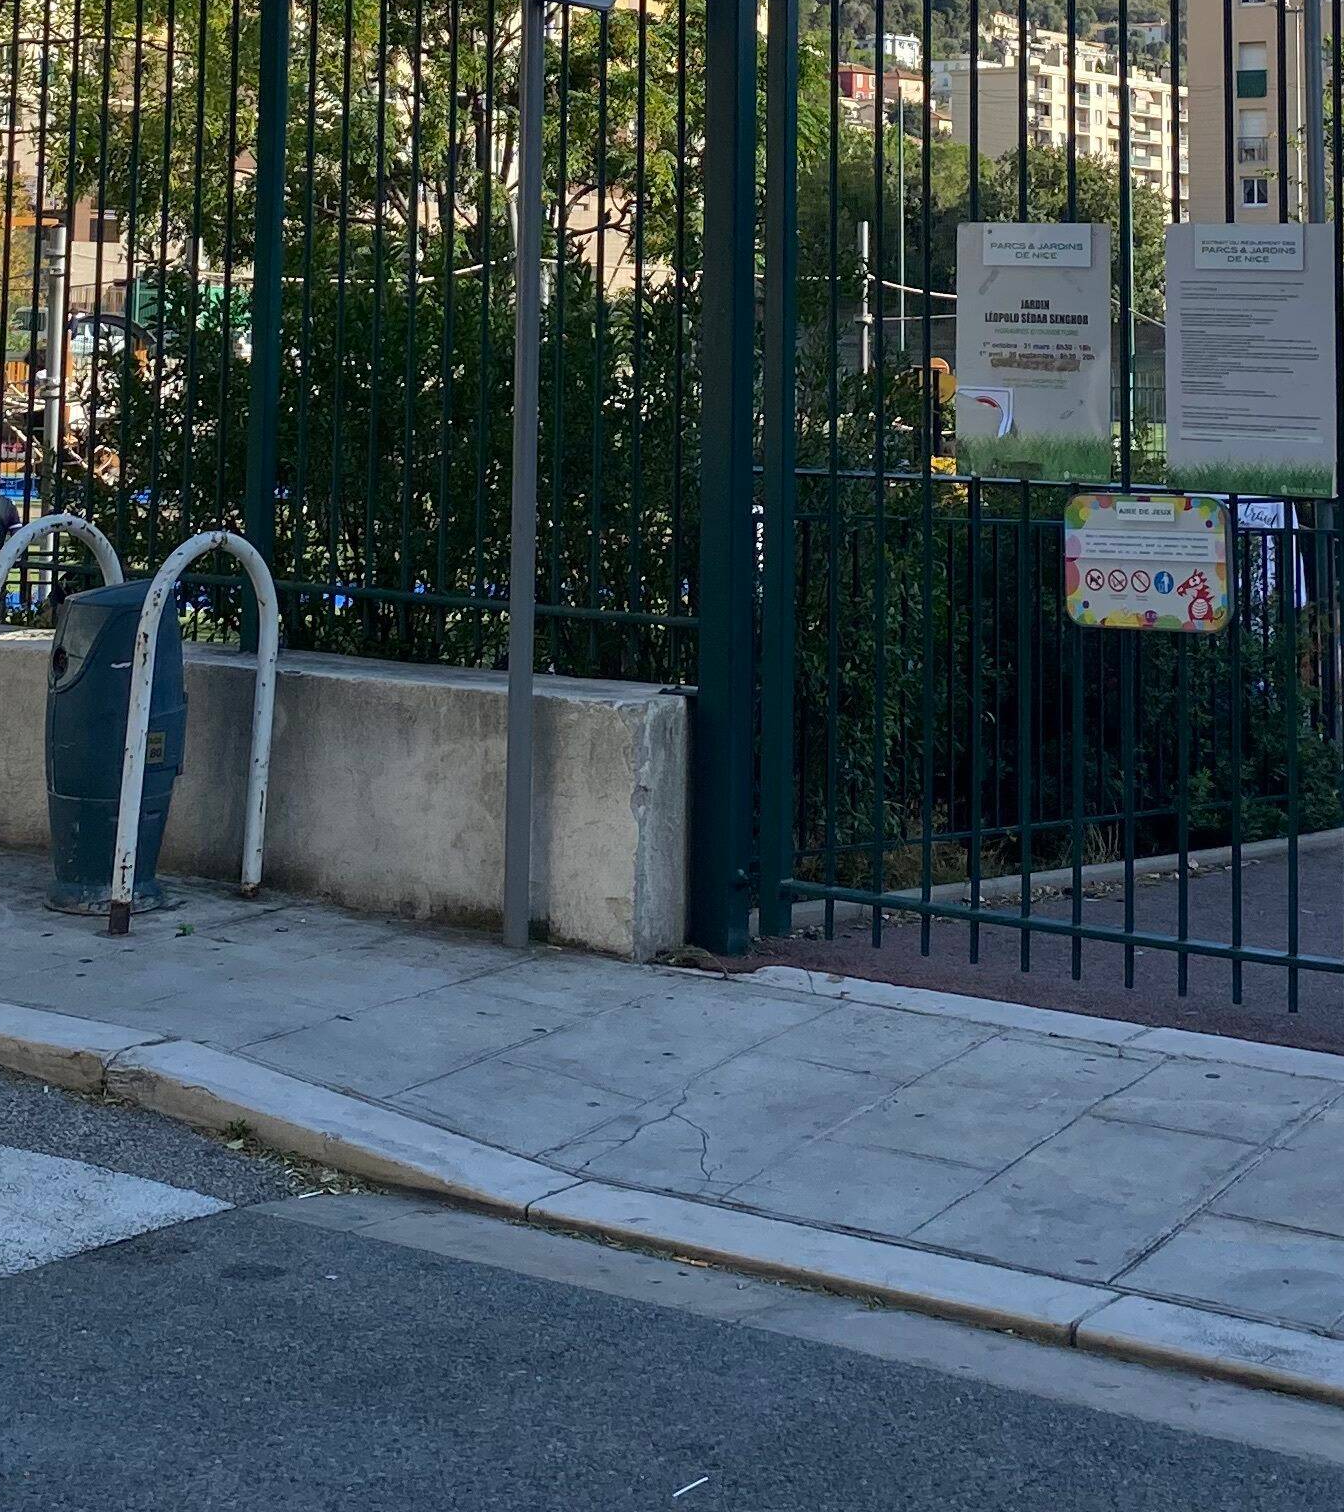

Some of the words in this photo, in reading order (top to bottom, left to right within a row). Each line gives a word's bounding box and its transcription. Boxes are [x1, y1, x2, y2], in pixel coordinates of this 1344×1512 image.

[1201, 246, 1238, 254] PARCS
[1239, 246, 1247, 254] &
[1249, 247, 1296, 255] JARDINS
[1032, 252, 1057, 260] NICE
[1227, 255, 1242, 263] DE
[1020, 299, 1050, 310] JARDIN
[1118, 508, 1136, 516] AIRE
